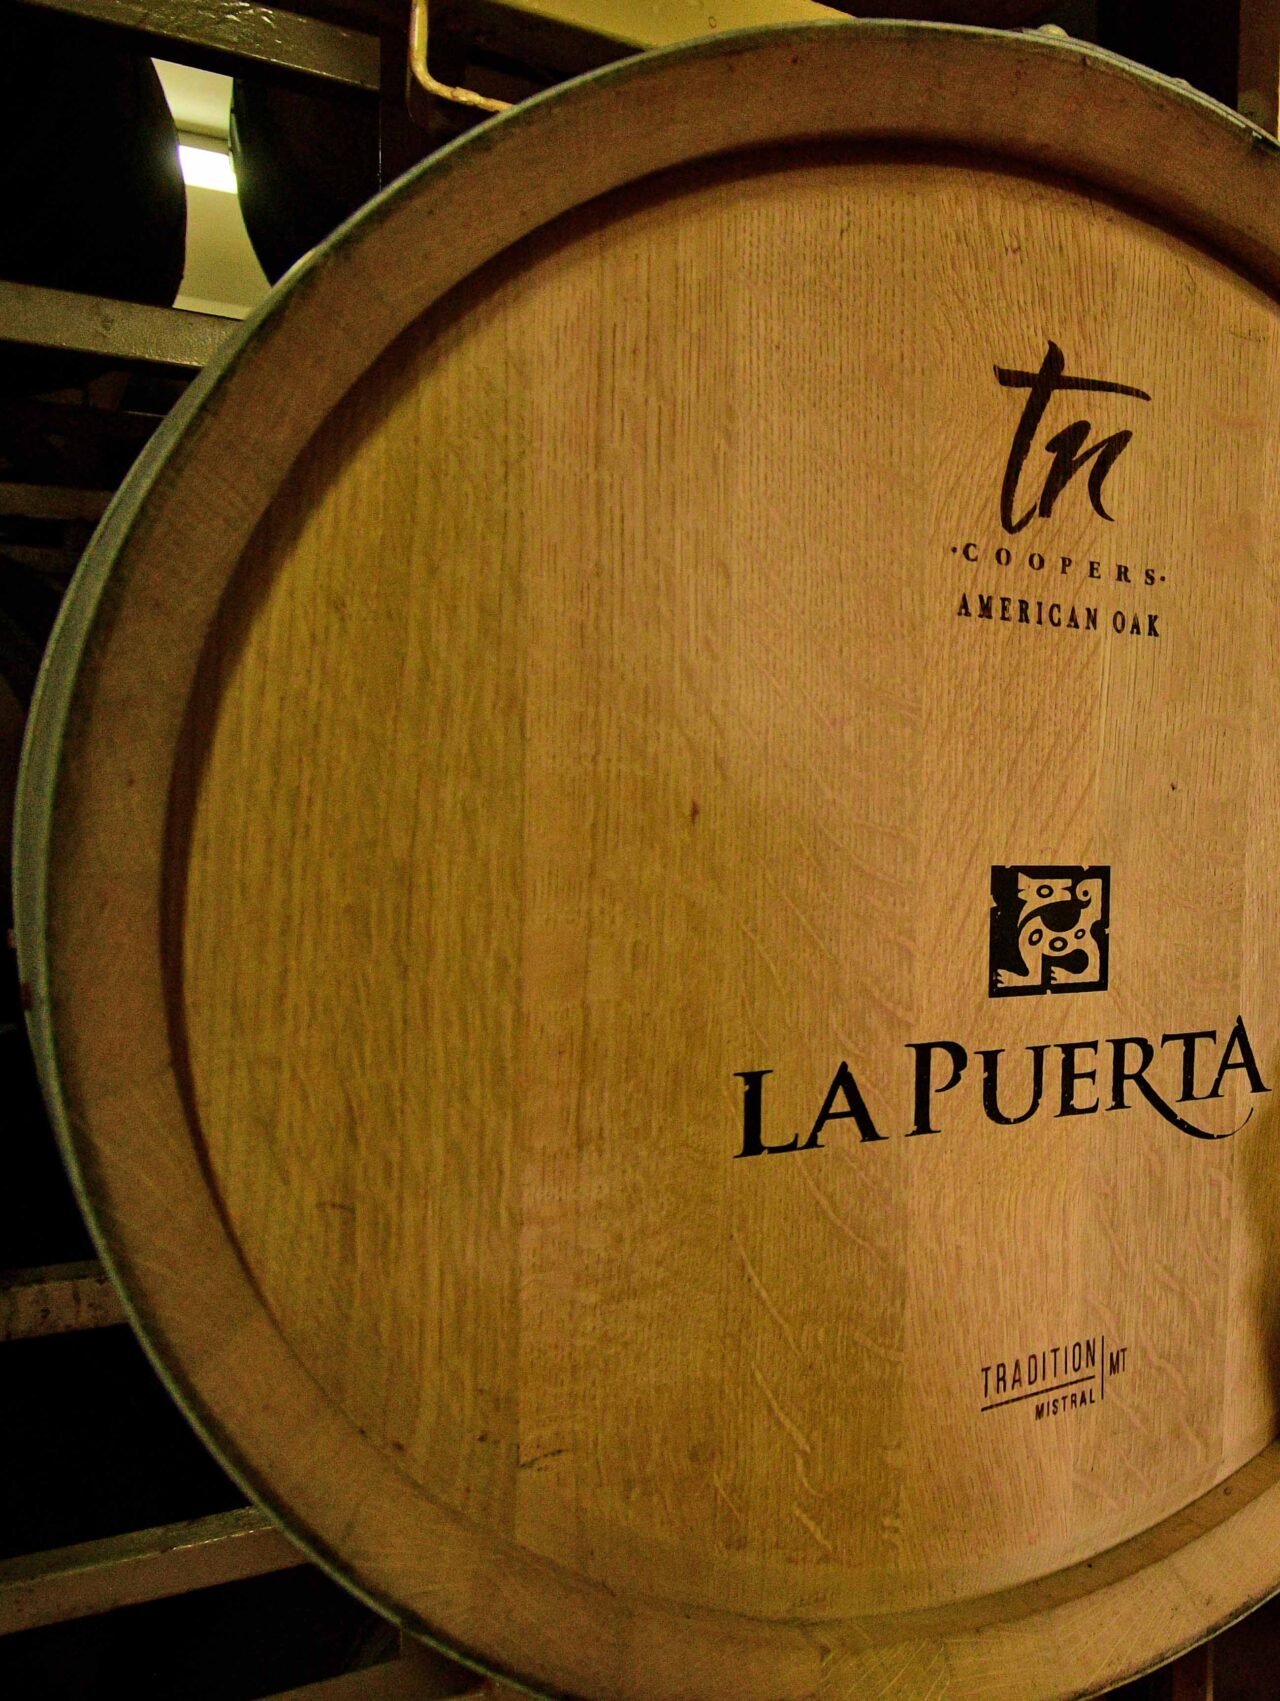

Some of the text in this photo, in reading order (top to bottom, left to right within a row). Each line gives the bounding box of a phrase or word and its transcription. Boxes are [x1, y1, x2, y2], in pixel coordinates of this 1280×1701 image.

[956, 593, 1160, 638] AMERICAN OAK
[733, 1014, 1272, 1158] LA PUERTA
[981, 1337, 1128, 1398] TRADITION MT
[1034, 1388, 1097, 1431] MISTRAL
